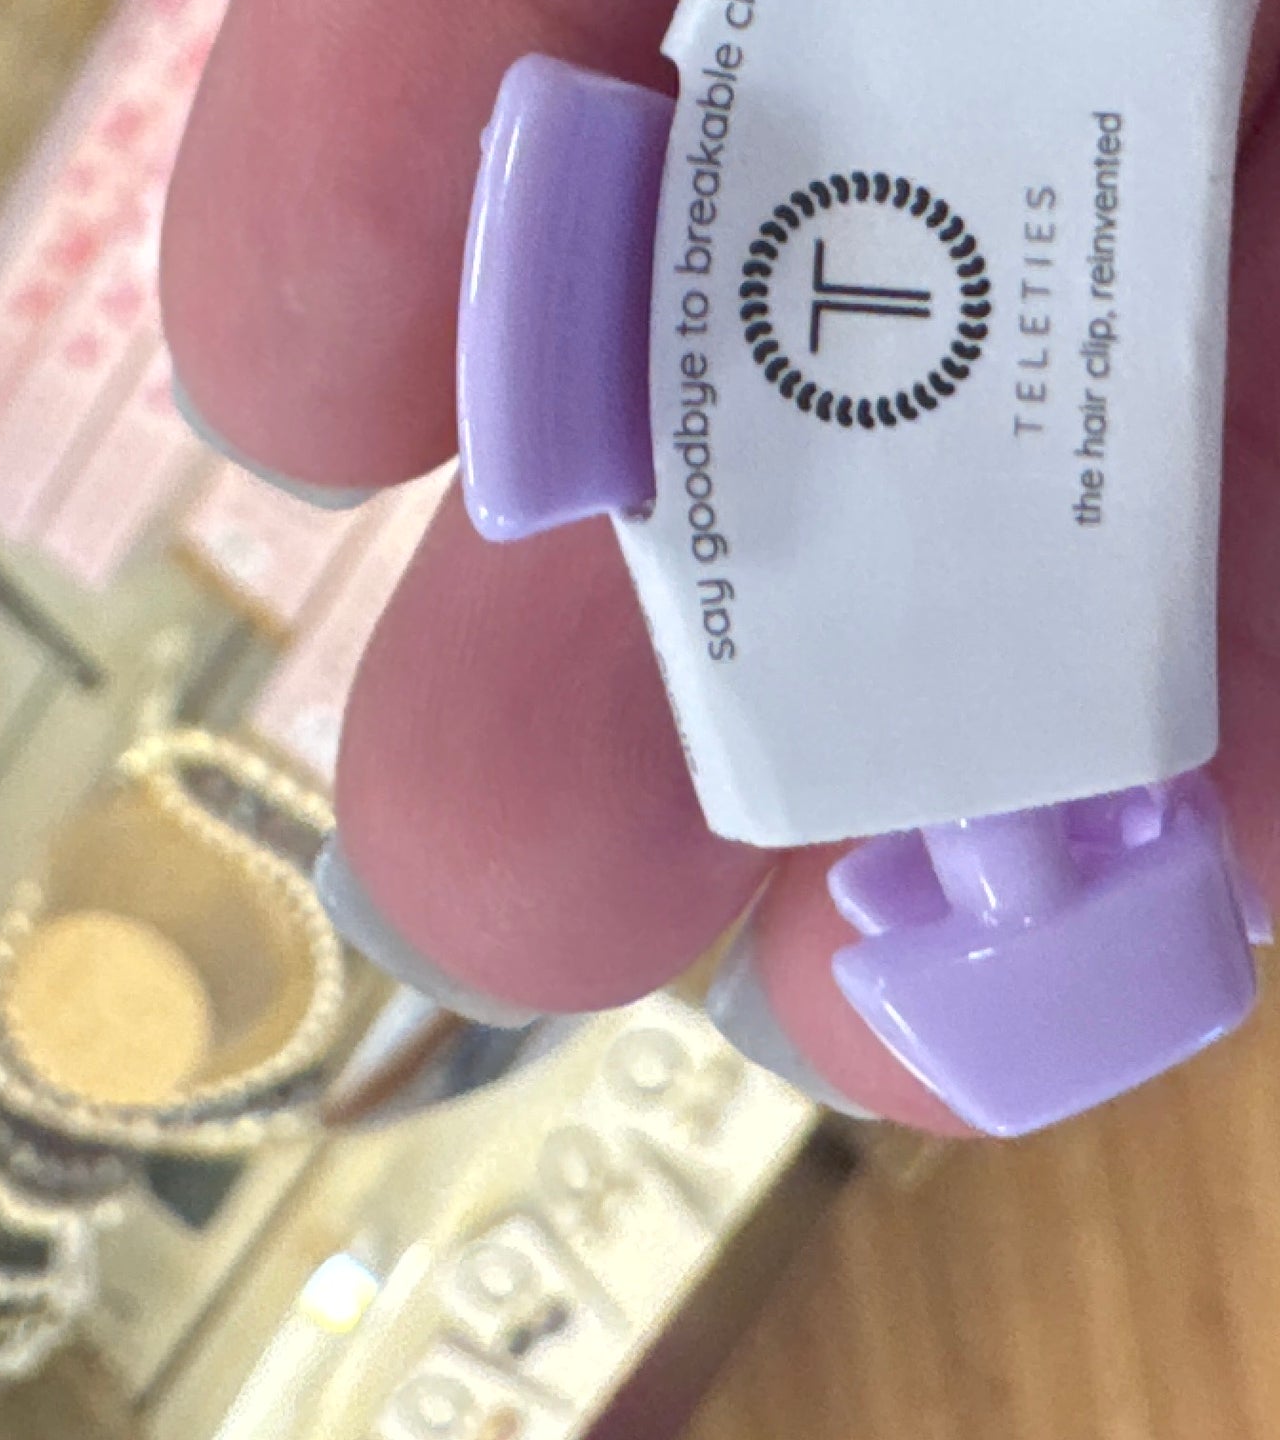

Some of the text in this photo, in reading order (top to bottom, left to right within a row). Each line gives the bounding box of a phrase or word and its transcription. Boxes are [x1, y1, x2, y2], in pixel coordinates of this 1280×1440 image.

[674, 41, 745, 274] breakable
[675, 290, 710, 336] to
[1014, 184, 1057, 438] TELETIES
[1072, 111, 1122, 527] the hair clip, reinvented
[673, 351, 729, 563] goodbye
[696, 578, 735, 661] say
